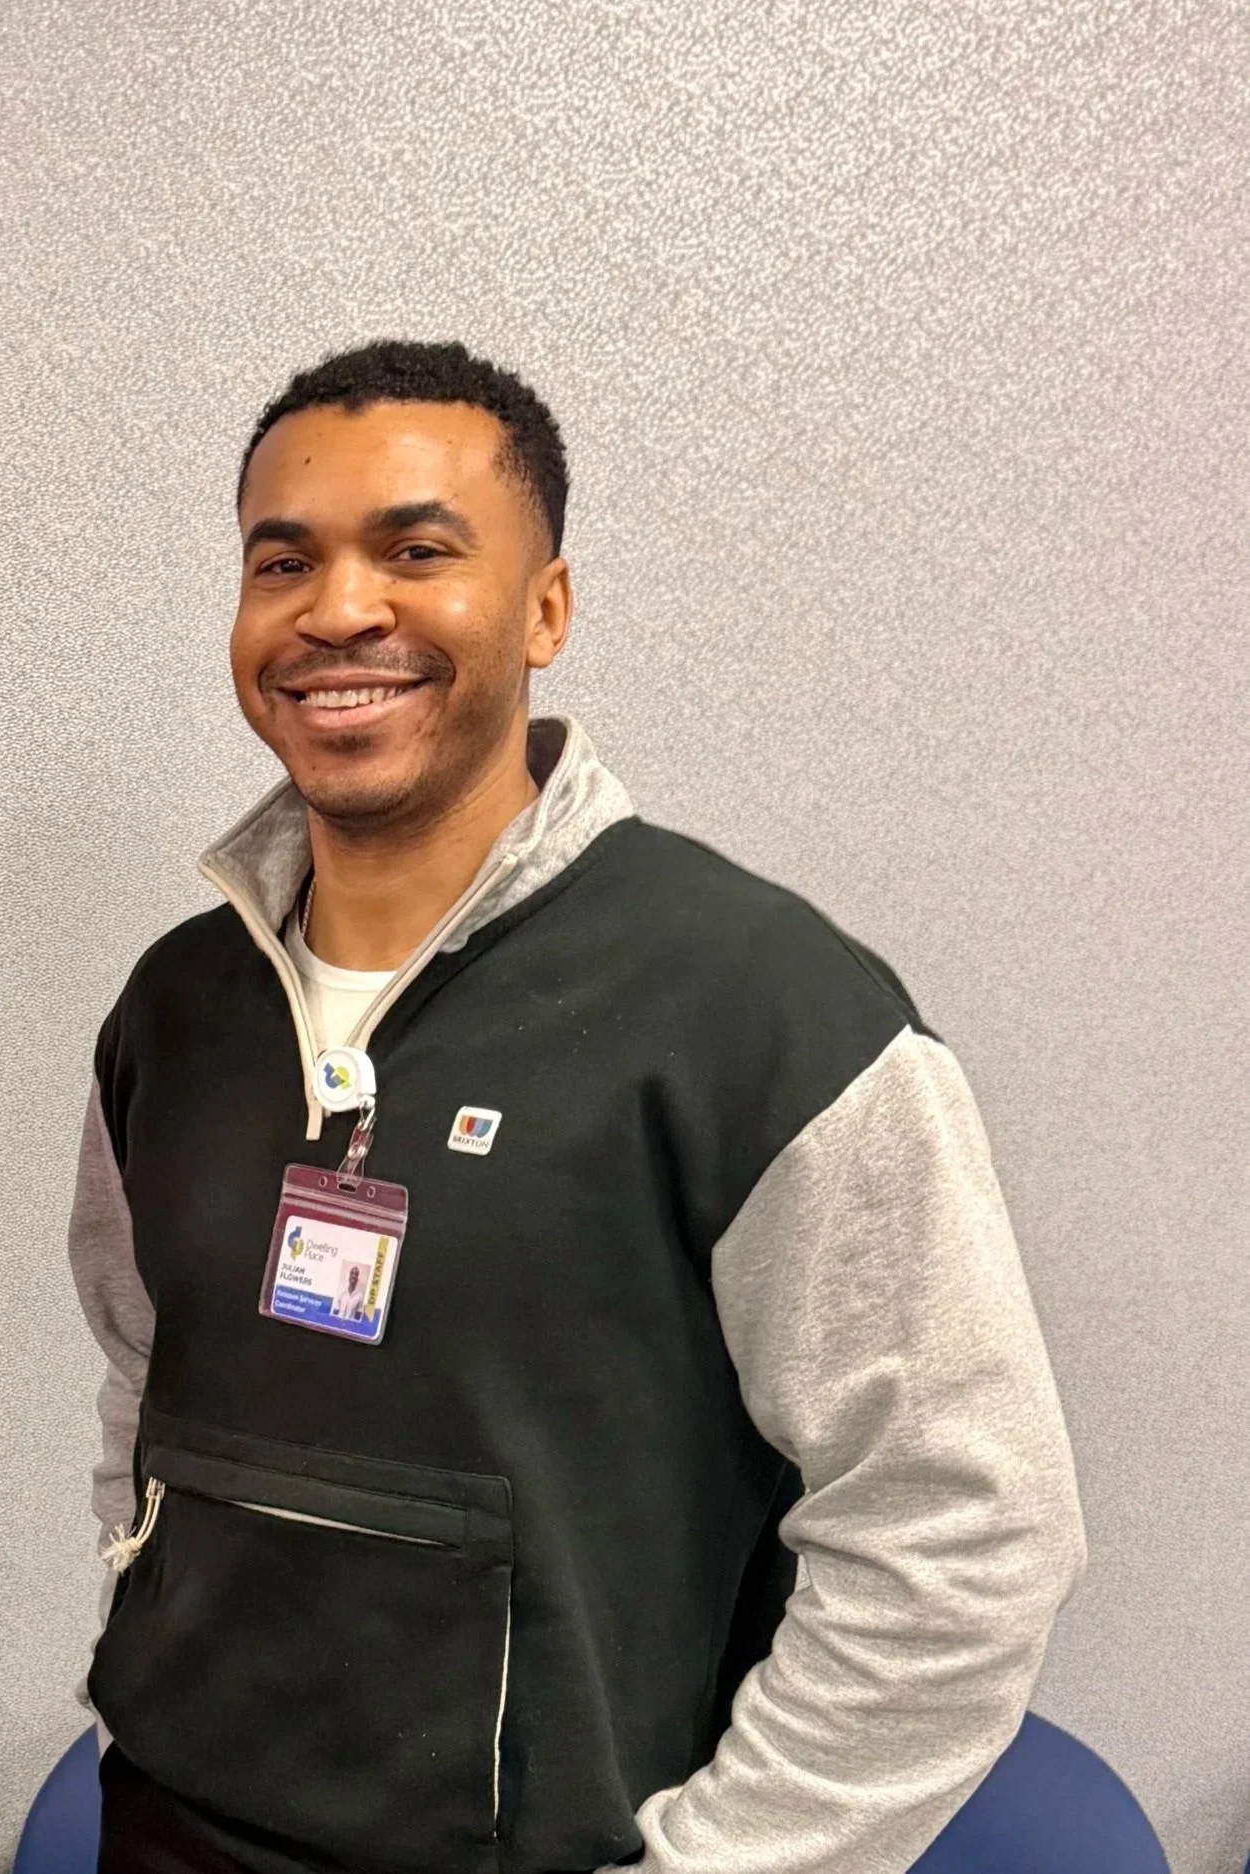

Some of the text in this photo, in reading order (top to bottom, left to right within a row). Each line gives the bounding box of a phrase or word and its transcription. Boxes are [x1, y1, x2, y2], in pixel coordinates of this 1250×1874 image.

[306, 1239, 338, 1258] Dwelling
[304, 1250, 324, 1262] Place
[281, 1263, 306, 1274] JULIAN
[279, 1272, 312, 1286] FLOWERS
[368, 1252, 384, 1305] DP STAFF
